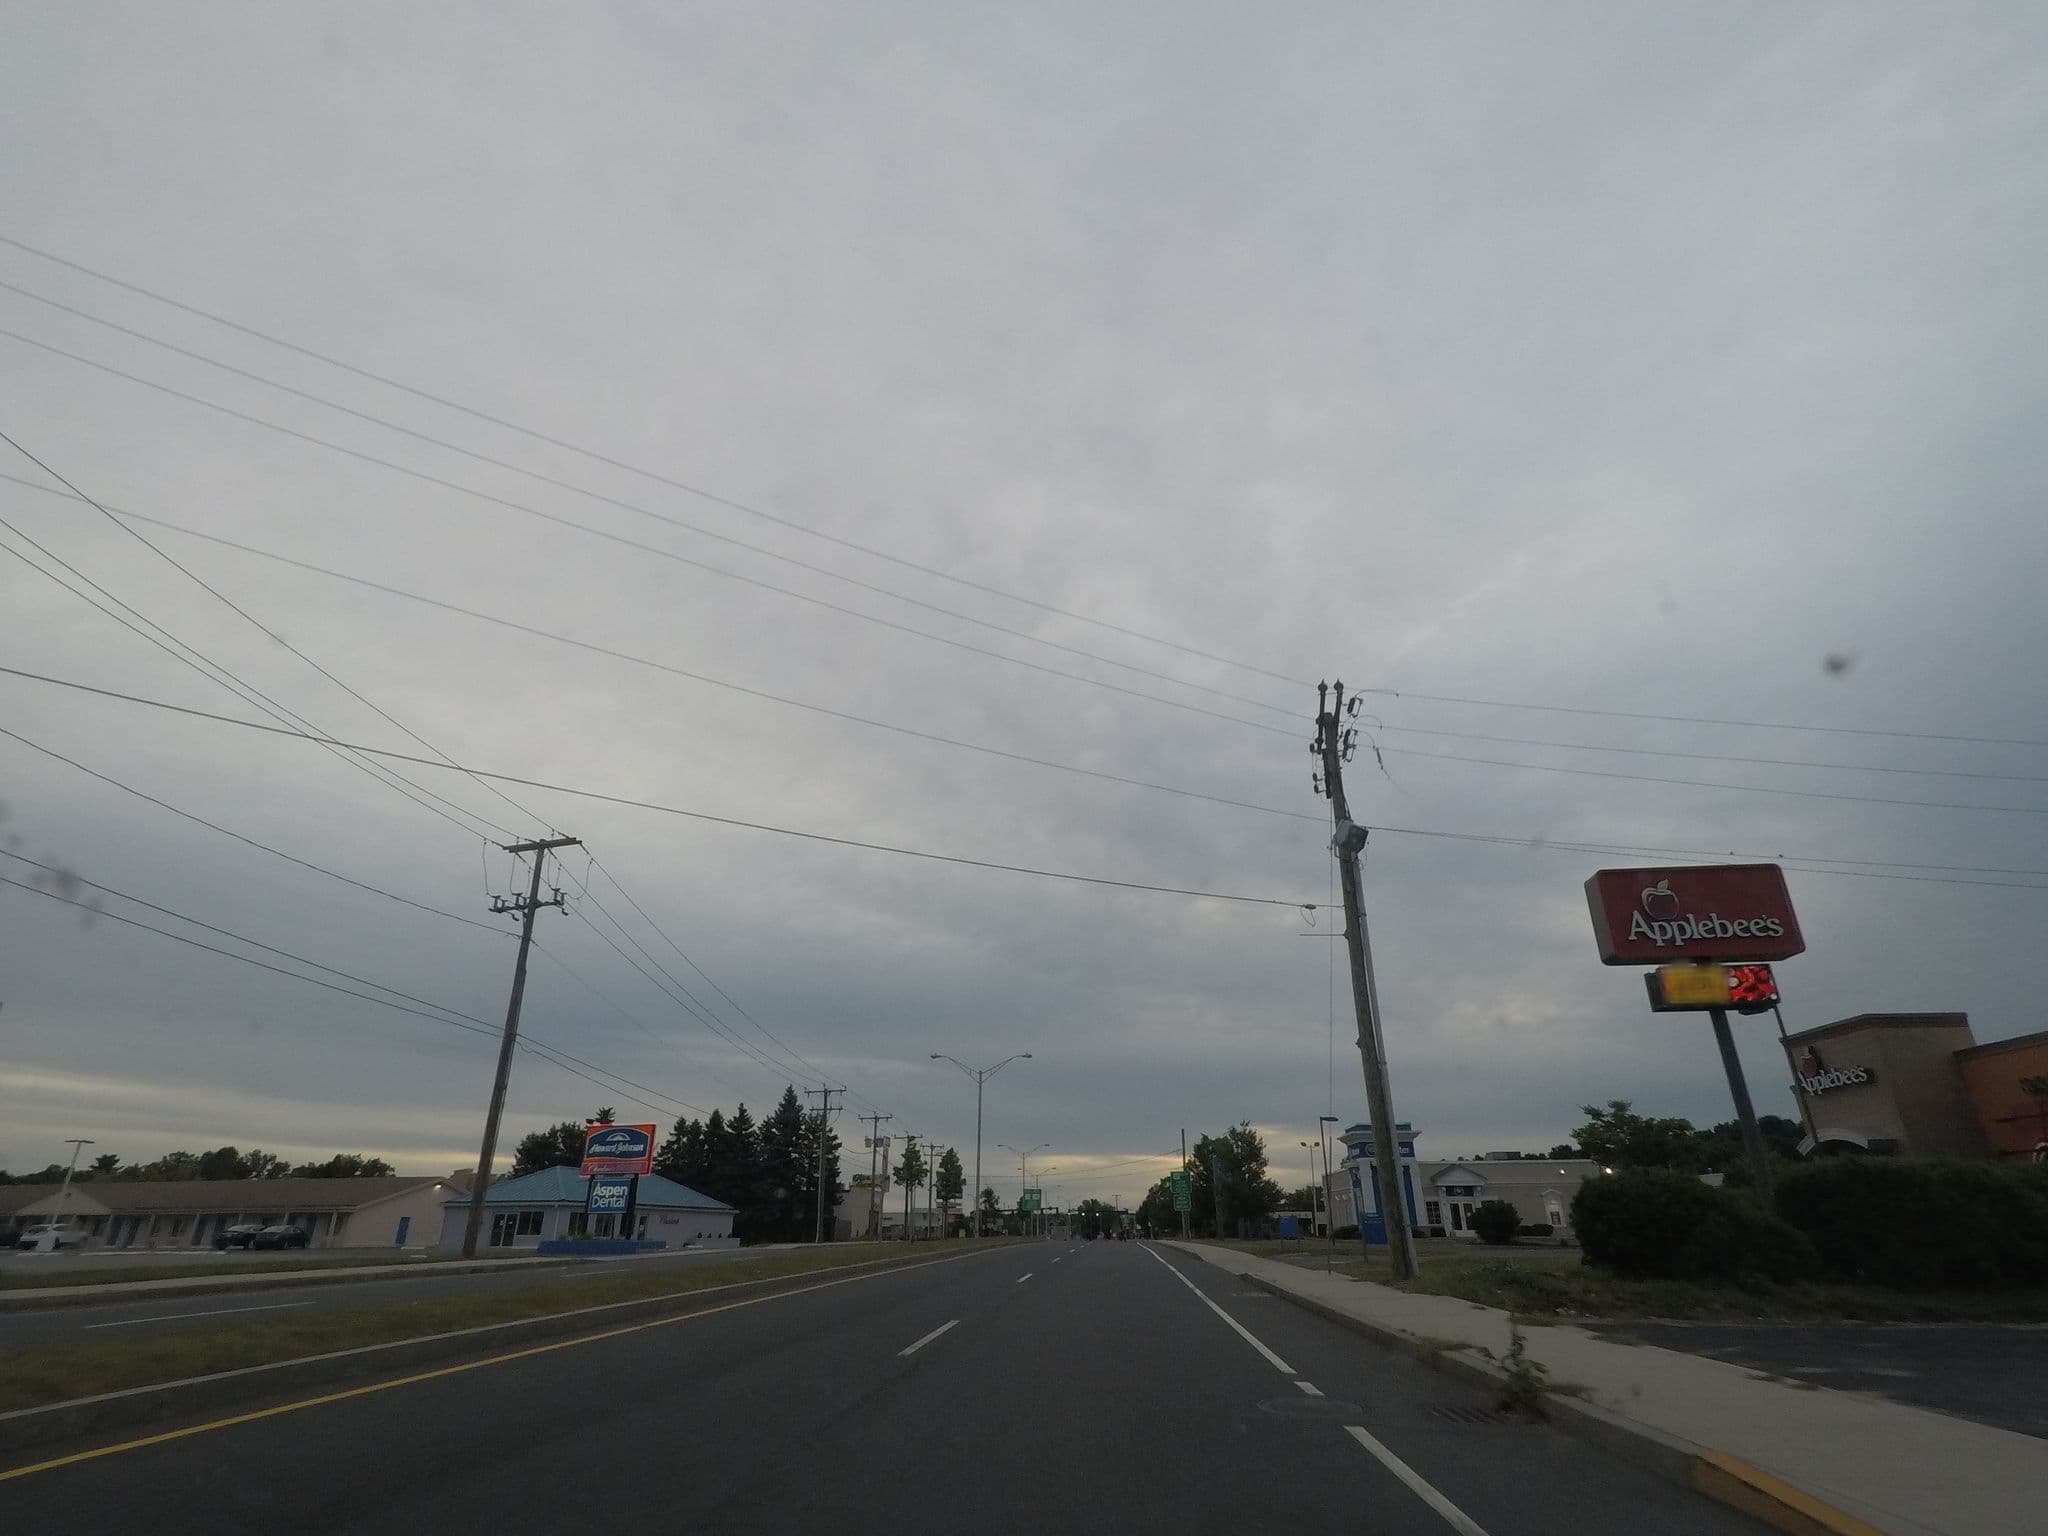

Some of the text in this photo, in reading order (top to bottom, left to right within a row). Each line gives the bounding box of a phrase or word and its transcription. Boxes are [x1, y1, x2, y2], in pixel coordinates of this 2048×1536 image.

[1628, 910, 1784, 946] Applebee's
[589, 1142, 645, 1155] Howard Johnson
[592, 1182, 628, 1197] Aspen
[591, 1196, 626, 1208] Dental
